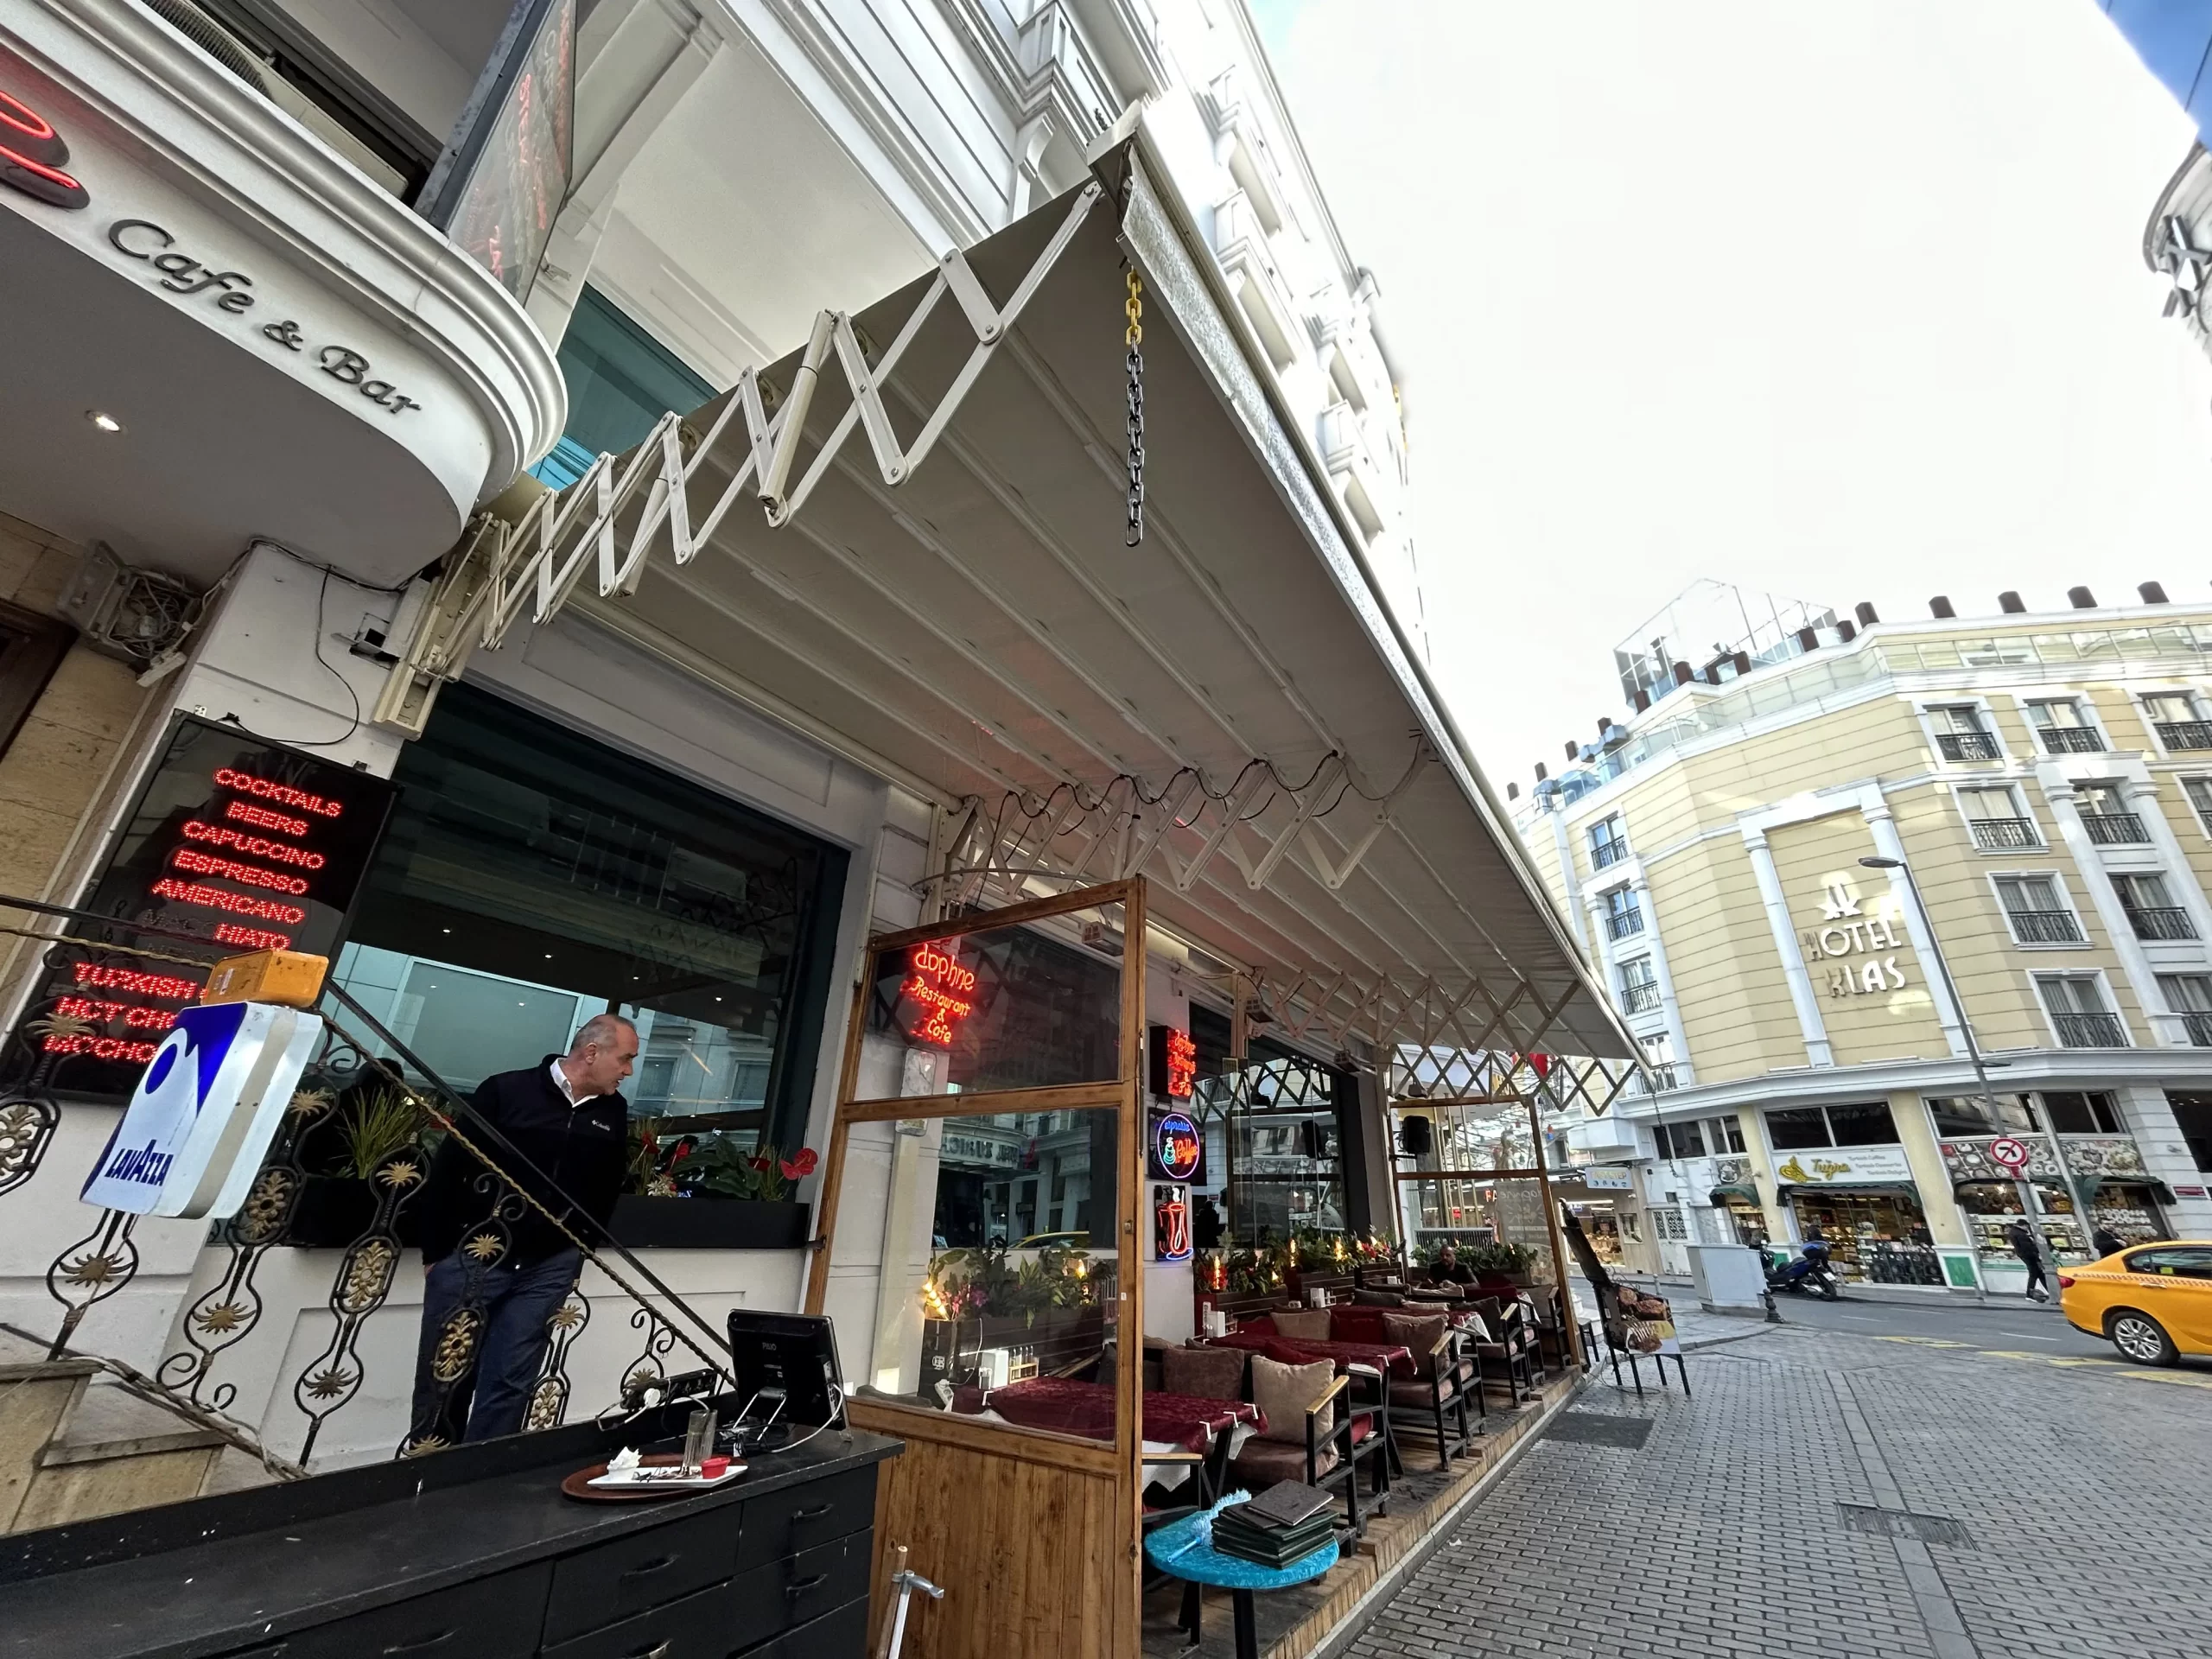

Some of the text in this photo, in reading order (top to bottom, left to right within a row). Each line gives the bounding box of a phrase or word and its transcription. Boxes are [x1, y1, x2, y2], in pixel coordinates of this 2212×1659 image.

[108, 219, 422, 414] Cafe & Bar
[214, 767, 342, 818] COCKTAILS
[226, 800, 309, 837] BEERS
[182, 820, 326, 870] CAPUCCINO
[174, 849, 308, 896] ESPRESSO
[150, 877, 305, 925] AMERICANO
[1802, 918, 1903, 962] HOTEL
[73, 961, 198, 1001] TURKISH
[911, 976, 971, 1017] Restaurant
[1823, 956, 1906, 998] KLAS
[104, 1139, 175, 1186] LAVAZZA
